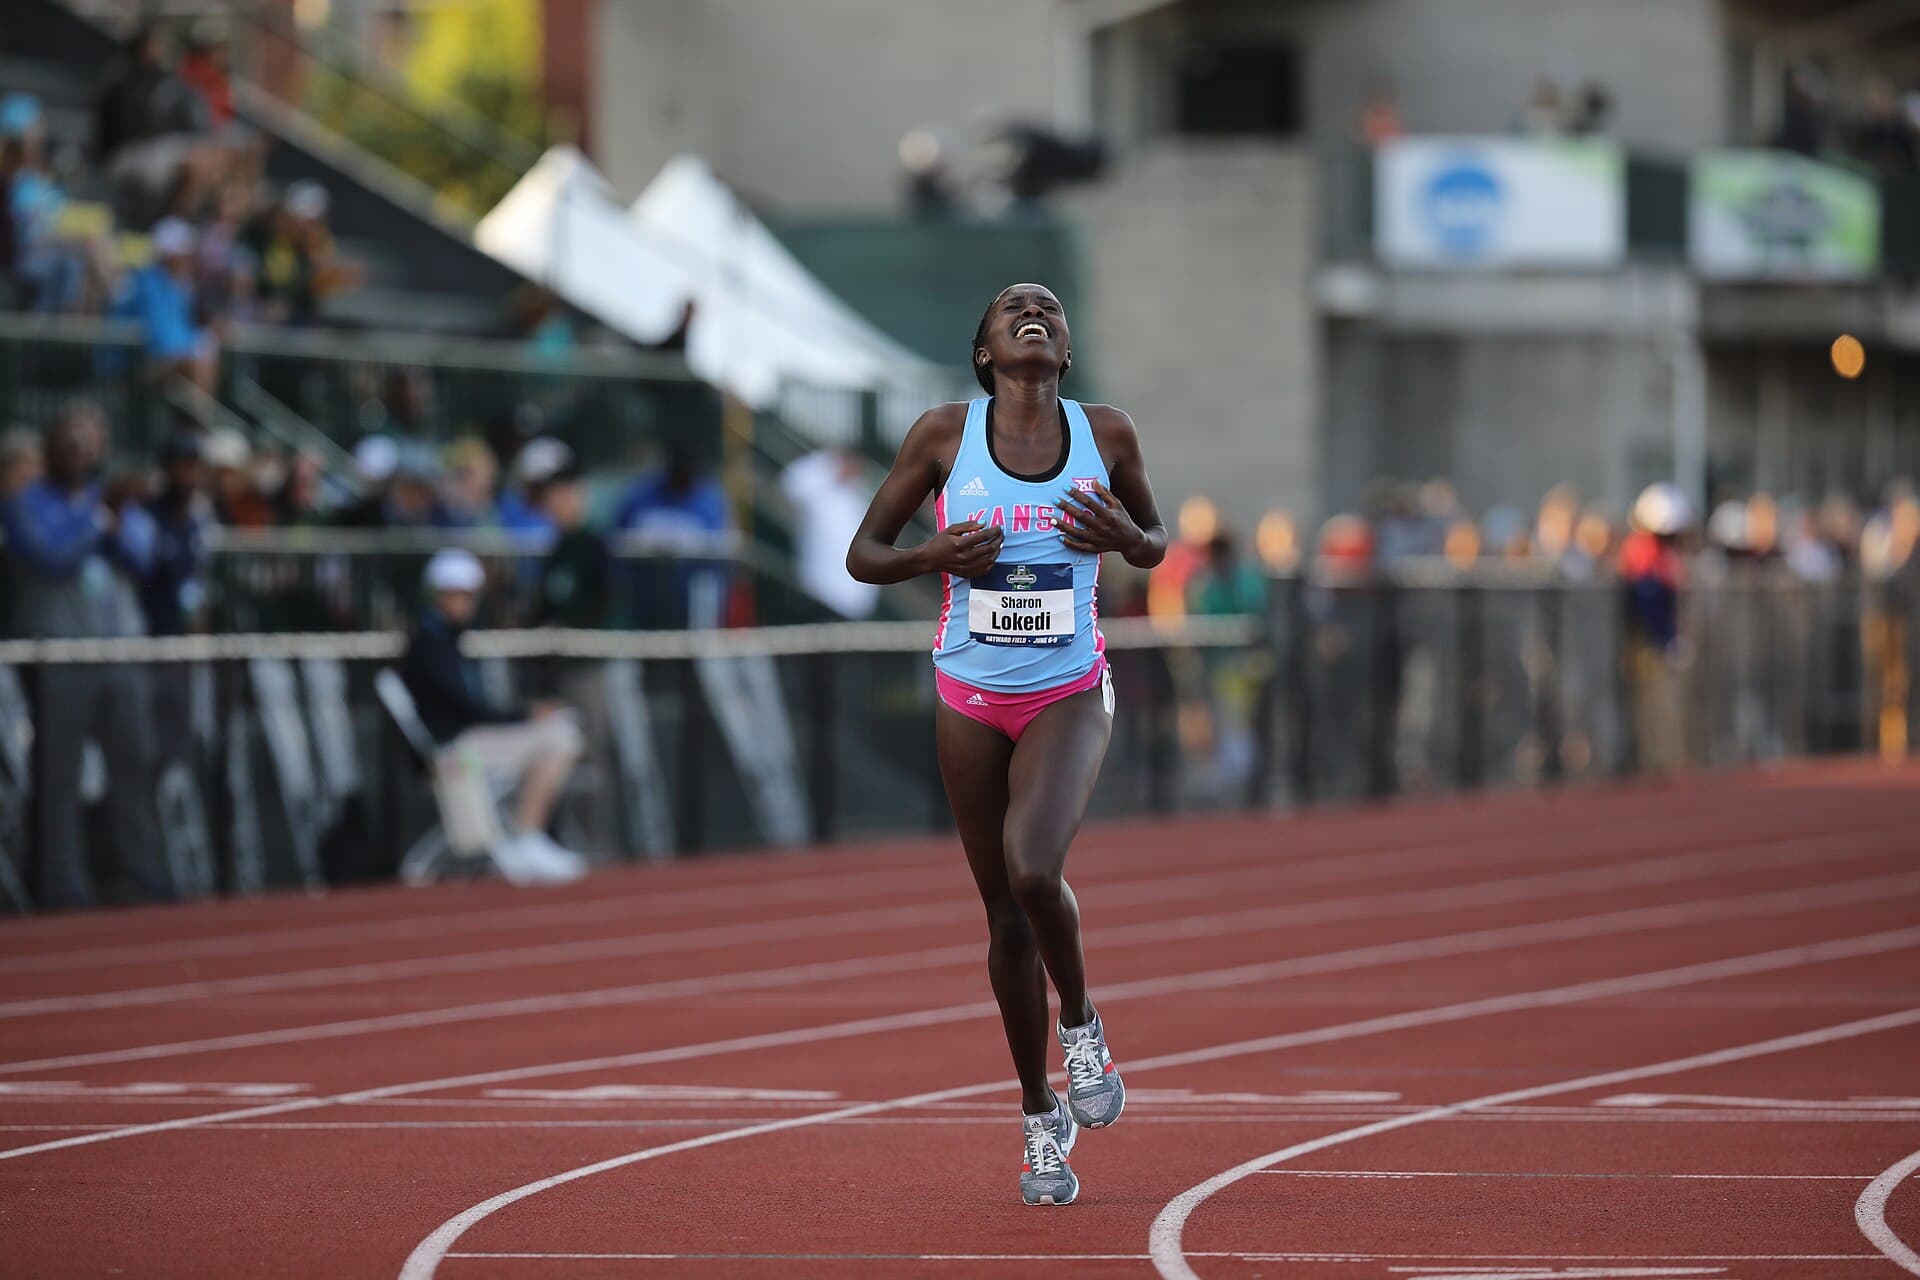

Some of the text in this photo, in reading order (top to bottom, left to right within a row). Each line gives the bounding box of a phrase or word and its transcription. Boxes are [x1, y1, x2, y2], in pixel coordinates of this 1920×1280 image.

[959, 488, 989, 497] adidas
[966, 503, 1096, 535] KANSA
[1001, 596, 1042, 609] Sharon
[991, 611, 1051, 631] Lokedi
[985, 635, 1011, 643] HAYWARD
[1011, 636, 1027, 644] FIELD
